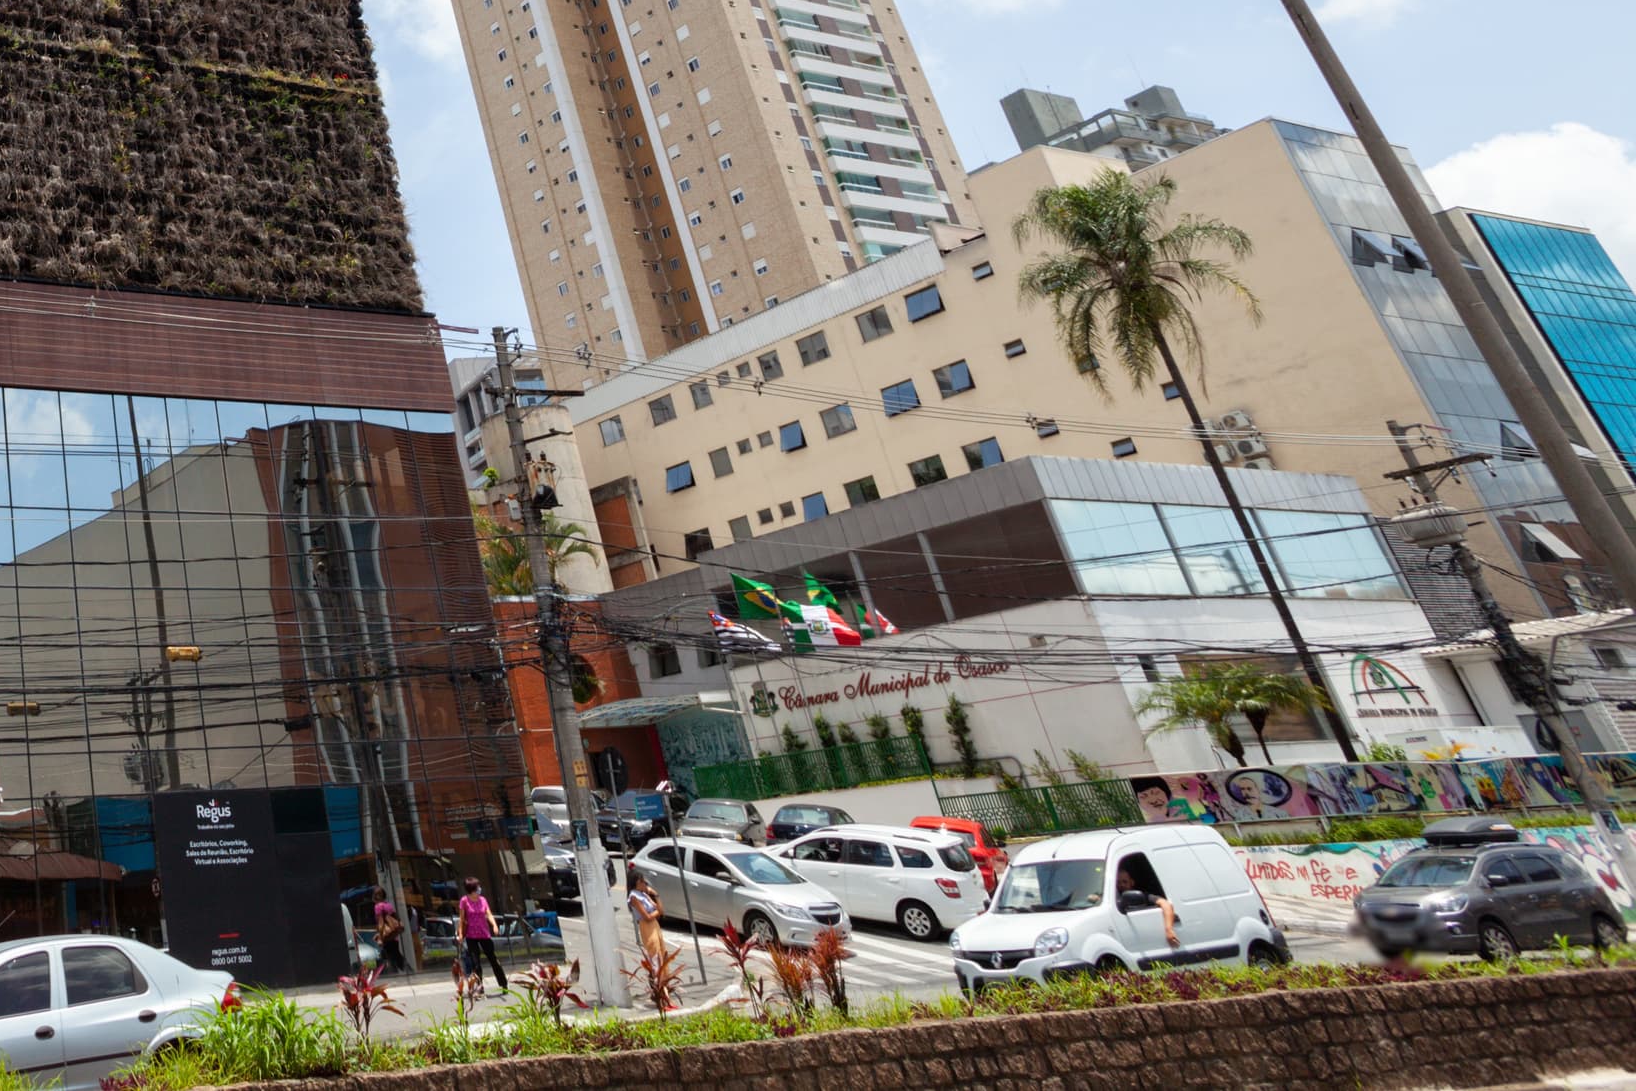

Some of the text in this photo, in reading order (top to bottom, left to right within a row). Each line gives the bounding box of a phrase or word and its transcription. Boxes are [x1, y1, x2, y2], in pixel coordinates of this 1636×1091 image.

[778, 654, 1011, 710] Câmara Municipal de Osasco
[196, 800, 231, 823] Regus
